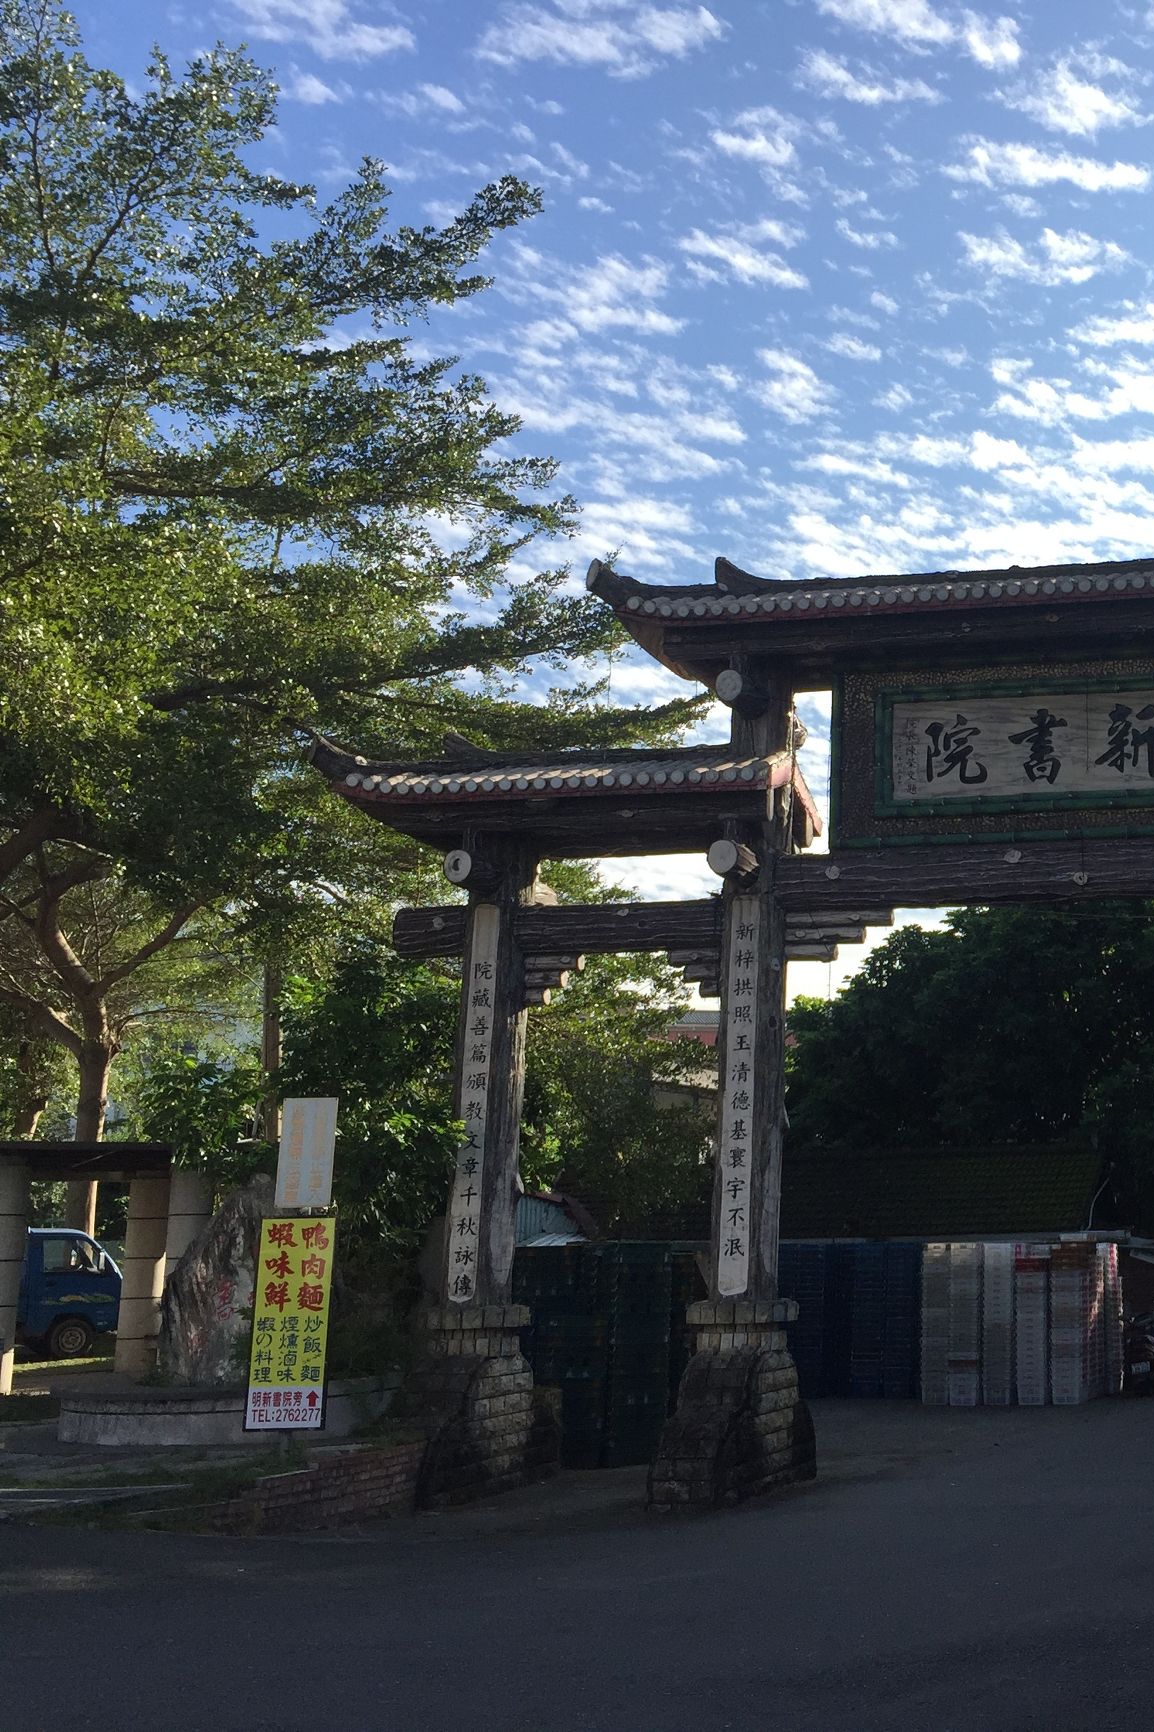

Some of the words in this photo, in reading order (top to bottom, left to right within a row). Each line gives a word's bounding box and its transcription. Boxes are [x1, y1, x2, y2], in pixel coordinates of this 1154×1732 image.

[264, 1222, 298, 1313] 蝦味鮮
[297, 1222, 329, 1312] 鴨肉麵
[253, 1316, 277, 1383] 蝦の料理
[251, 1391, 303, 1407] 明新書院旁
